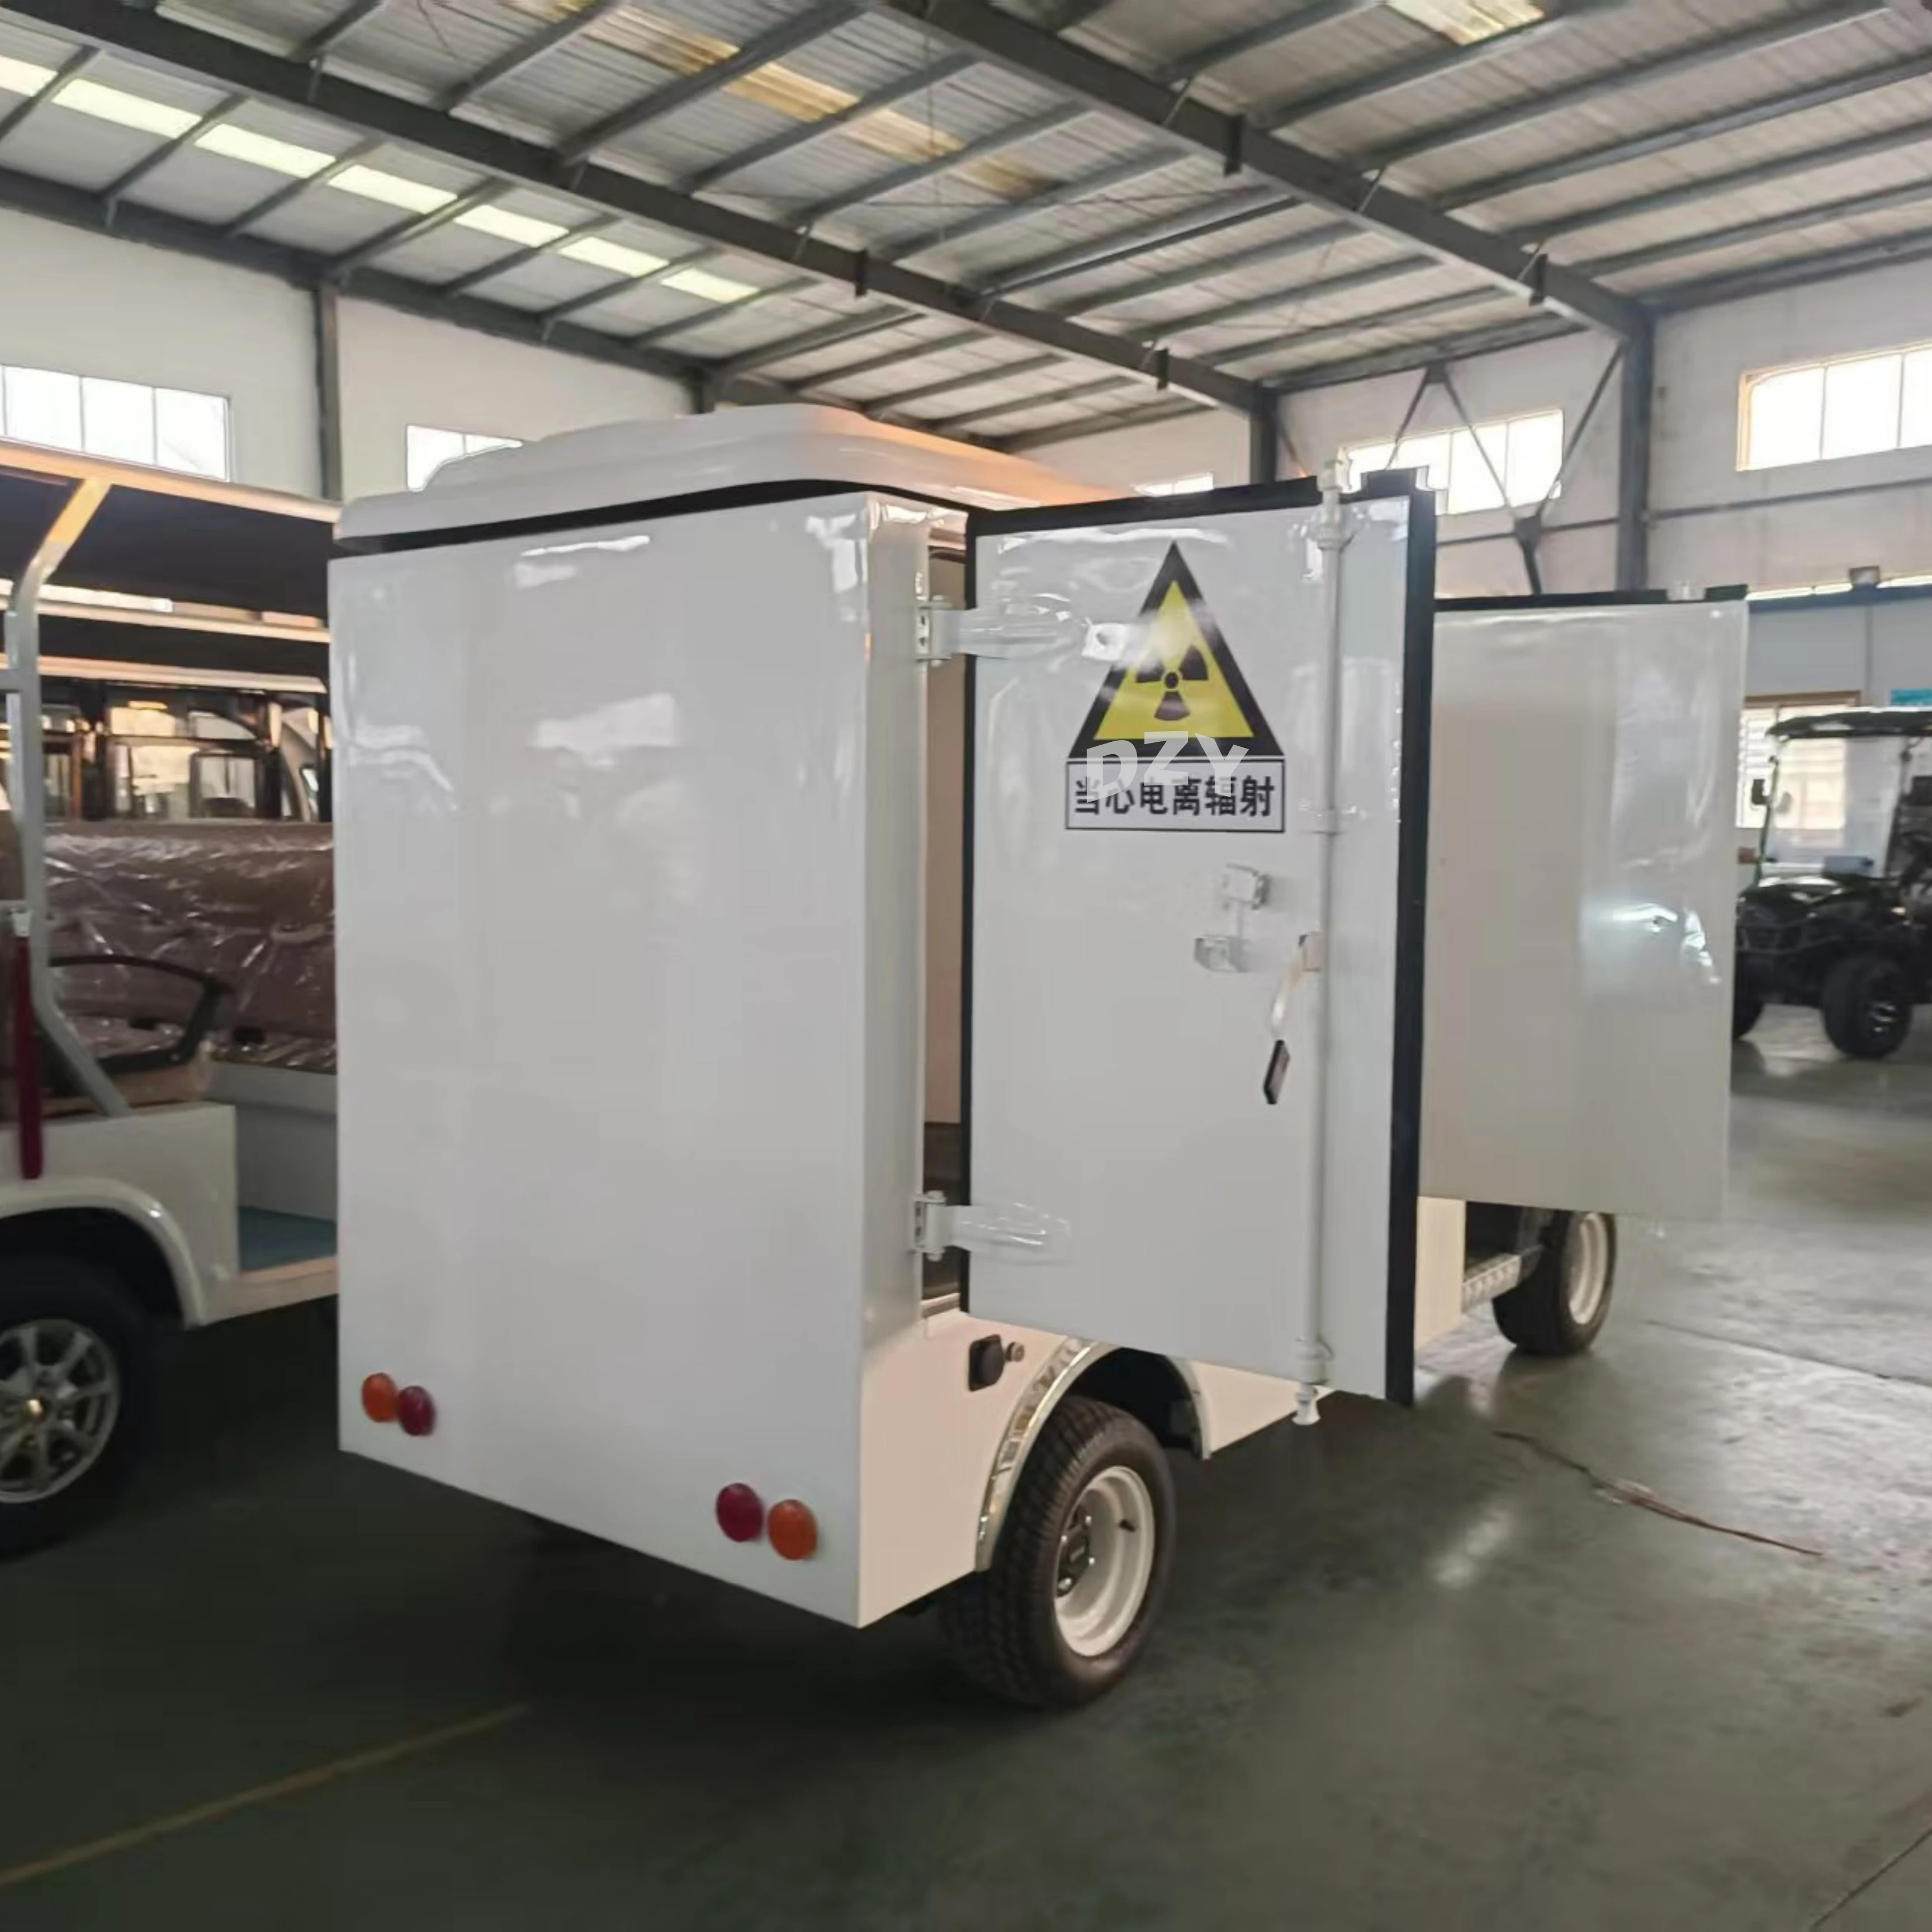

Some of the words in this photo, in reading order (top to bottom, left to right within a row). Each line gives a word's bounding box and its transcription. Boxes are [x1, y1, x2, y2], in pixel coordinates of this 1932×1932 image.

[1074, 775, 1275, 817] 当心电离辐射
